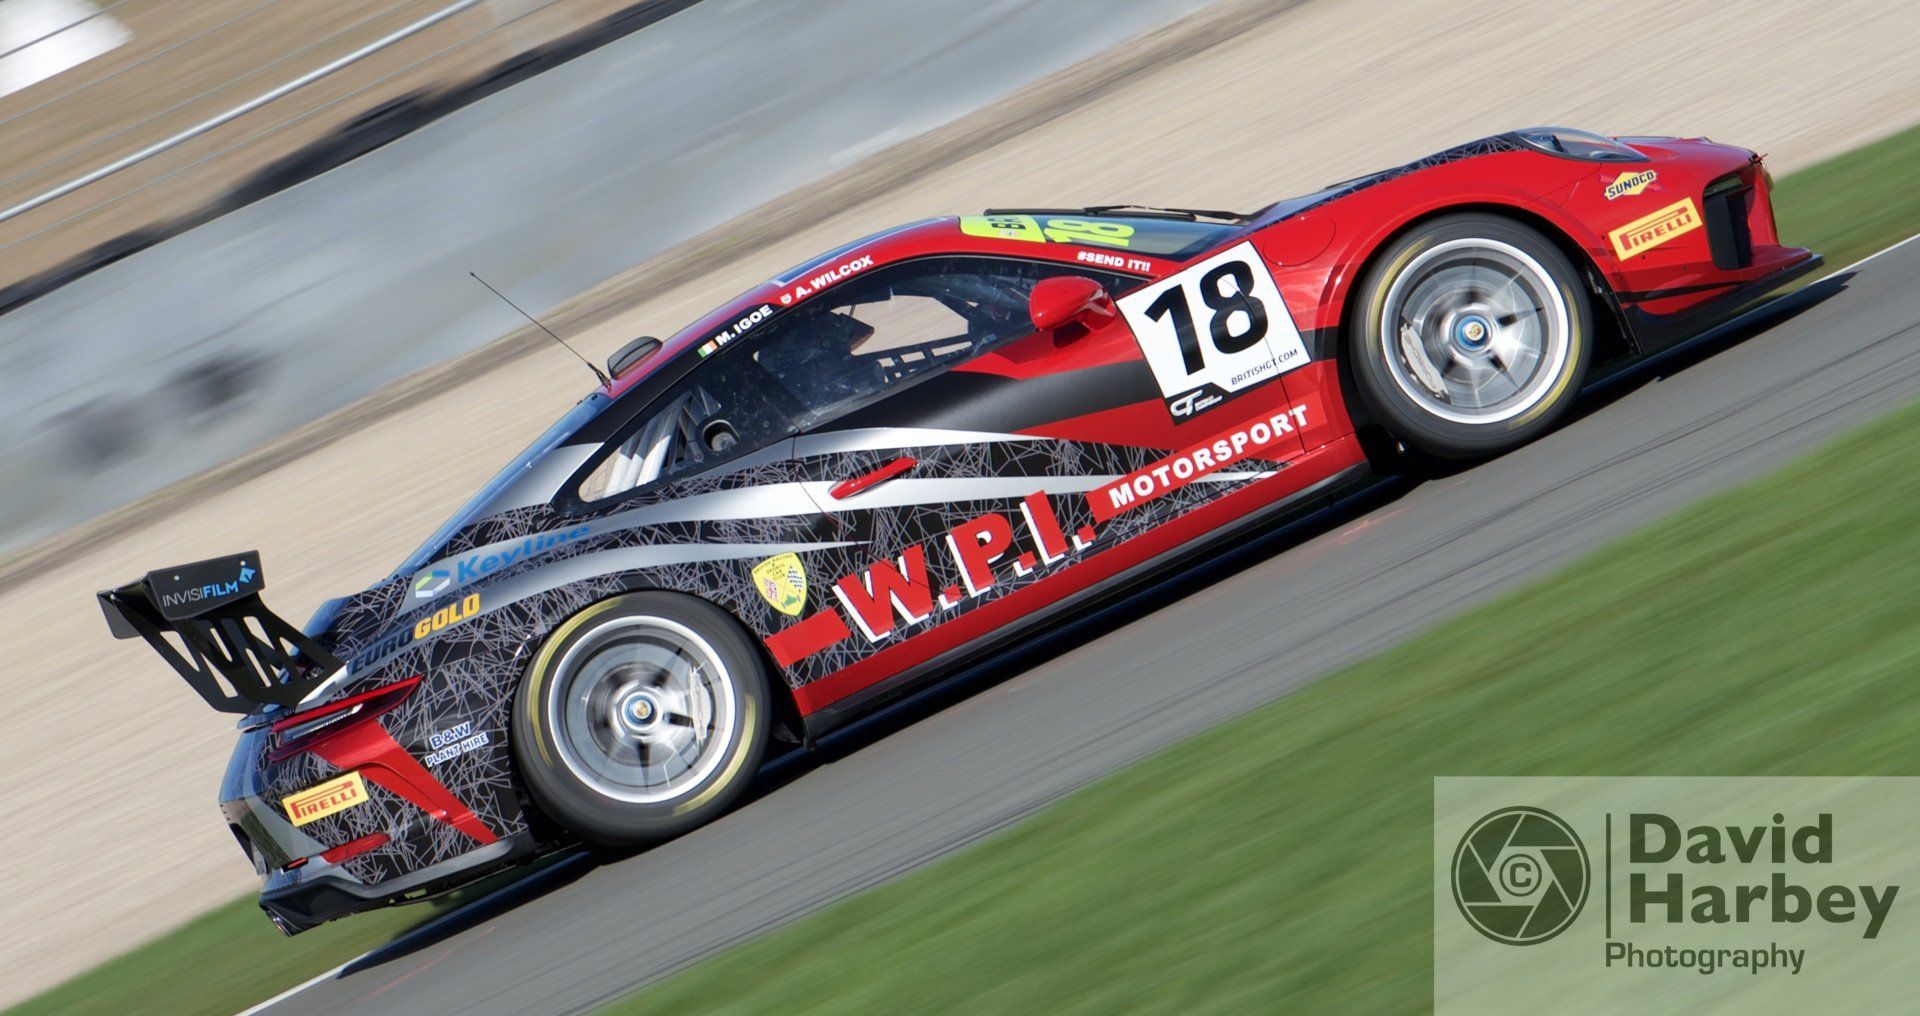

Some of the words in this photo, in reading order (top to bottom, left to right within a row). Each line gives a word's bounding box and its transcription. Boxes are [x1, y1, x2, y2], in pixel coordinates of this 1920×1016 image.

[1607, 170, 1656, 199] SUNOCO
[1618, 206, 1693, 252] PIRELLI
[795, 285, 812, 300] A.
[810, 254, 875, 291] WILCOX
[1077, 250, 1125, 268] #SEND
[1127, 259, 1152, 272] IT!!
[715, 331, 736, 347] M.
[735, 304, 774, 335] IGOE
[1144, 260, 1269, 376] 18
[1231, 348, 1299, 386] BRITISHGT.COM
[832, 490, 1097, 643] W.P.I.
[1108, 404, 1308, 508] MOTORSPORT
[457, 526, 590, 584] Keyline
[162, 580, 239, 608] INVISIFILM
[351, 593, 480, 674] EUROGOLD
[425, 744, 461, 767] PLANT
[462, 733, 489, 752] HIRE
[430, 722, 471, 749] B&W
[290, 780, 358, 819] PIRELLI
